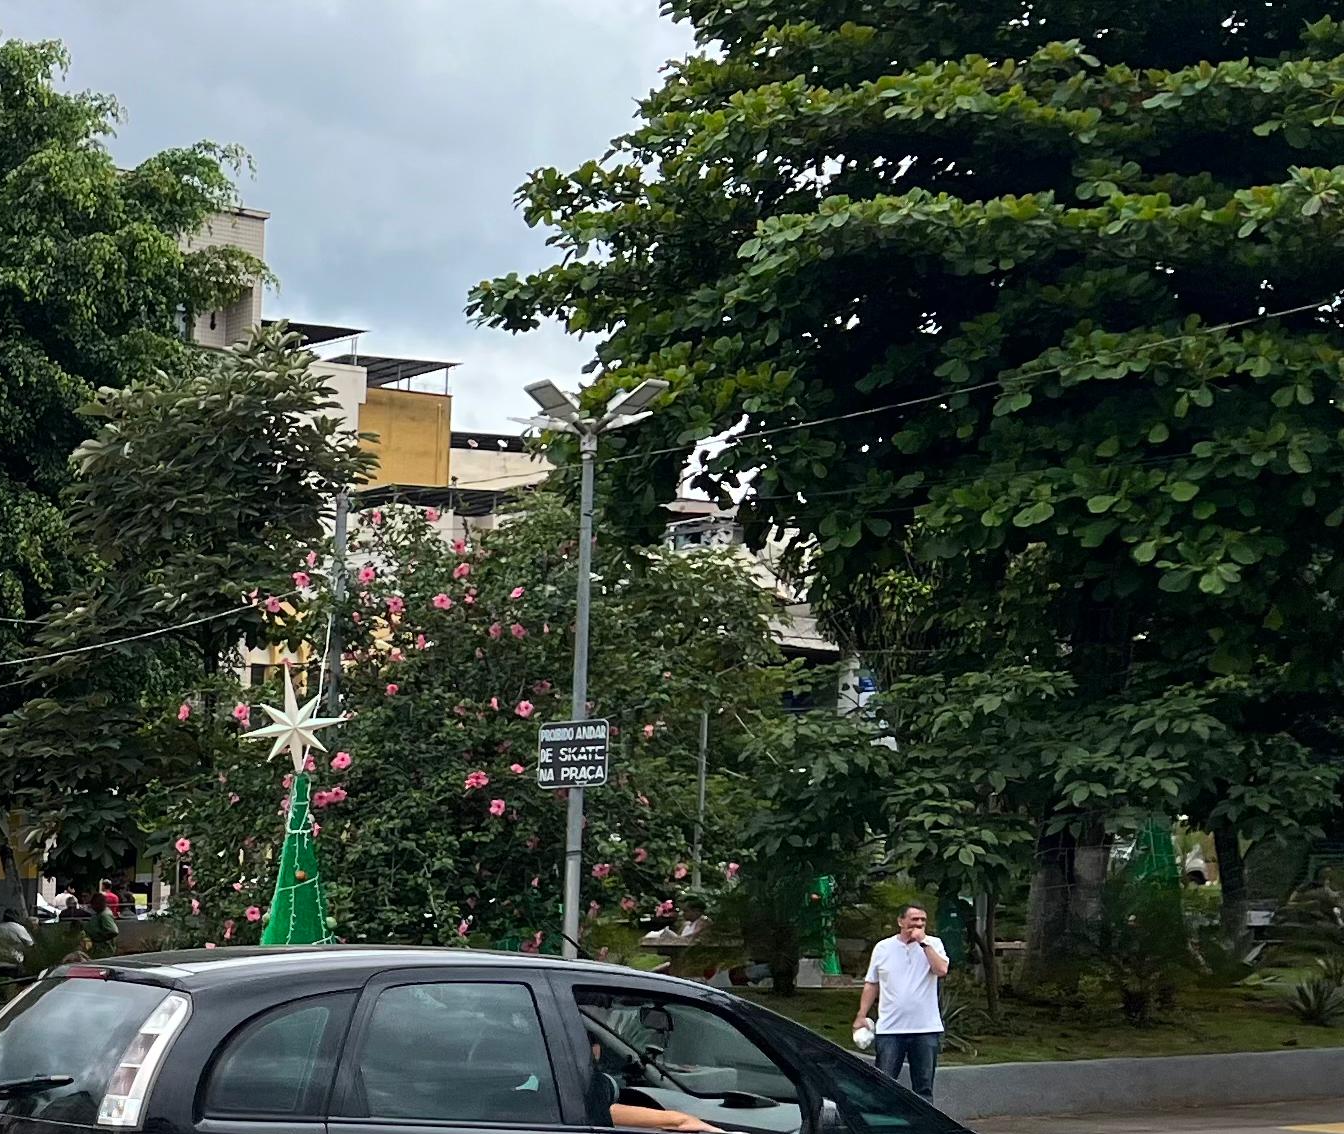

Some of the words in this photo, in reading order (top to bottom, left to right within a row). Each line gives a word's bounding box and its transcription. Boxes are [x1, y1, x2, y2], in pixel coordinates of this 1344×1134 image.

[540, 727, 575, 742] PROIBIDO
[575, 724, 606, 740] ANDAR
[540, 747, 554, 763] DE
[558, 745, 605, 762] SKATE
[539, 767, 555, 782] NA
